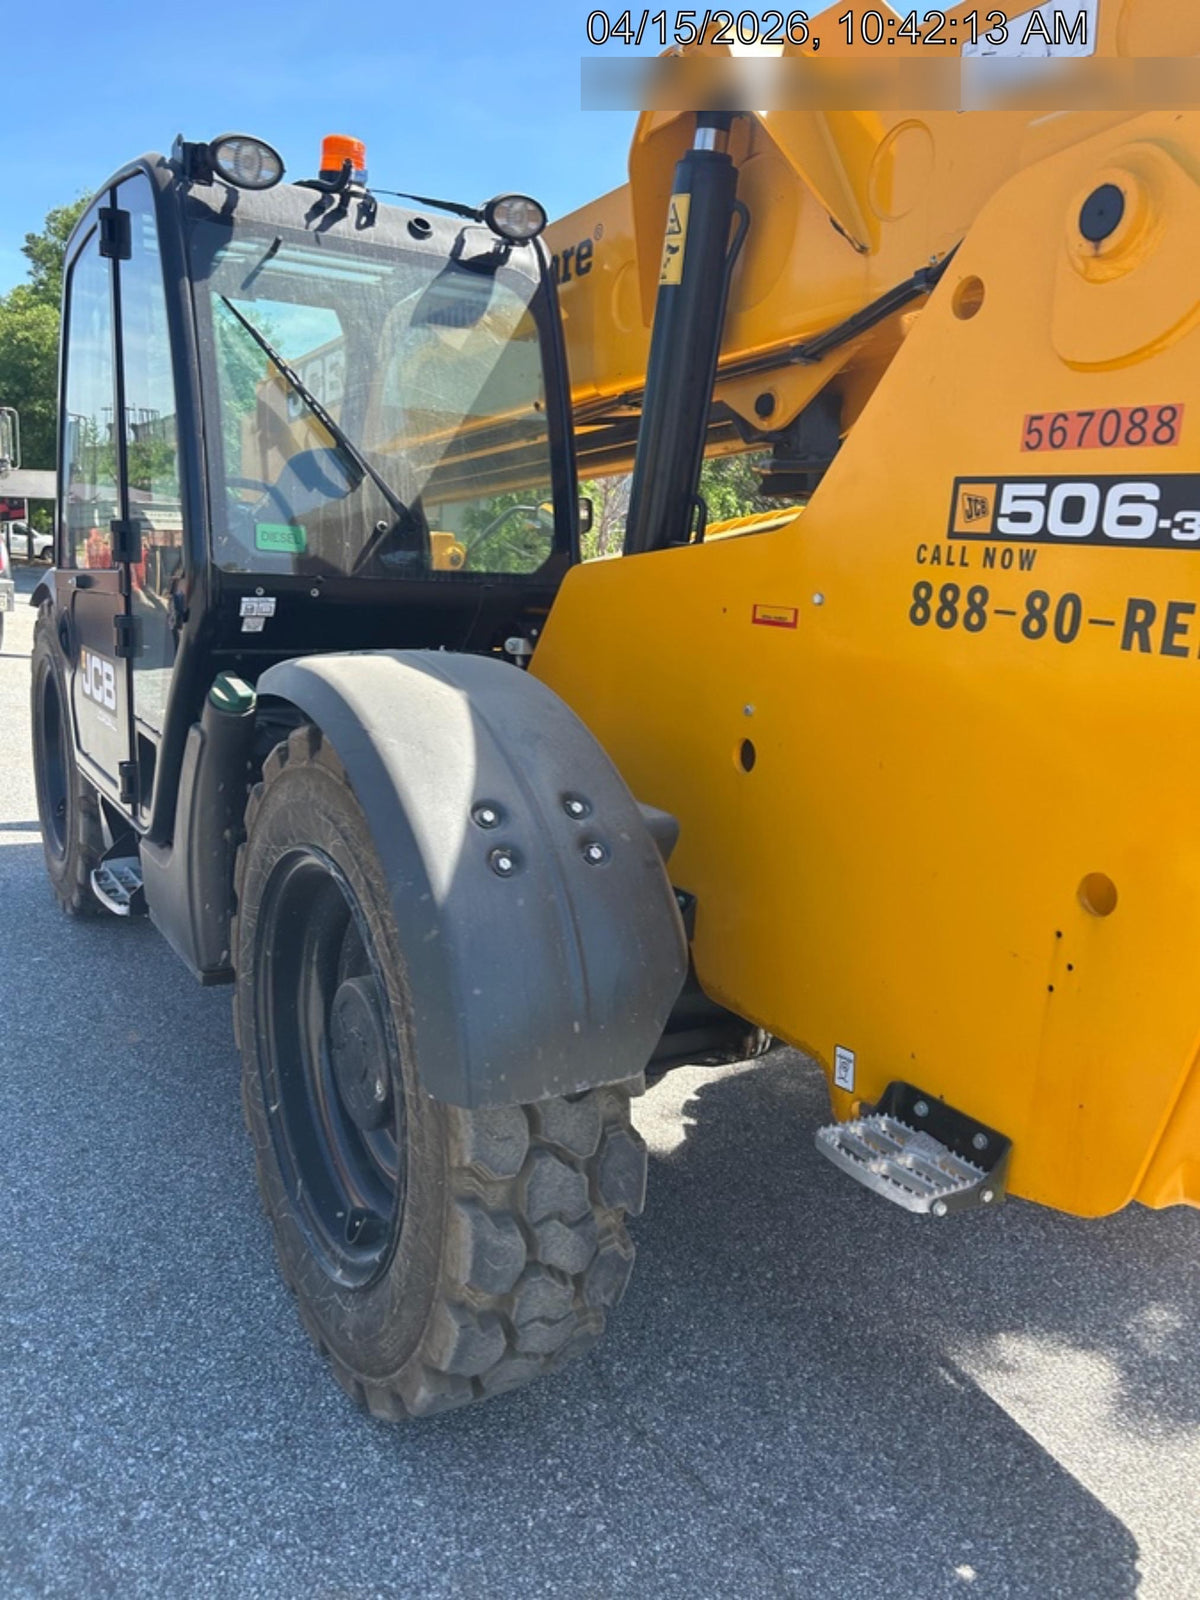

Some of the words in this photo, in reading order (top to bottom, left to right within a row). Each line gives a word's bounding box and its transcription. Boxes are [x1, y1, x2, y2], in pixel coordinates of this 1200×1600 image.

[1025, 405, 1178, 451] 567088
[261, 531, 300, 545] DIESEL
[916, 544, 970, 568] CALL
[983, 546, 1037, 571] NOW
[909, 580, 1200, 660] 888-80-RE
[82, 652, 116, 711] JCB
